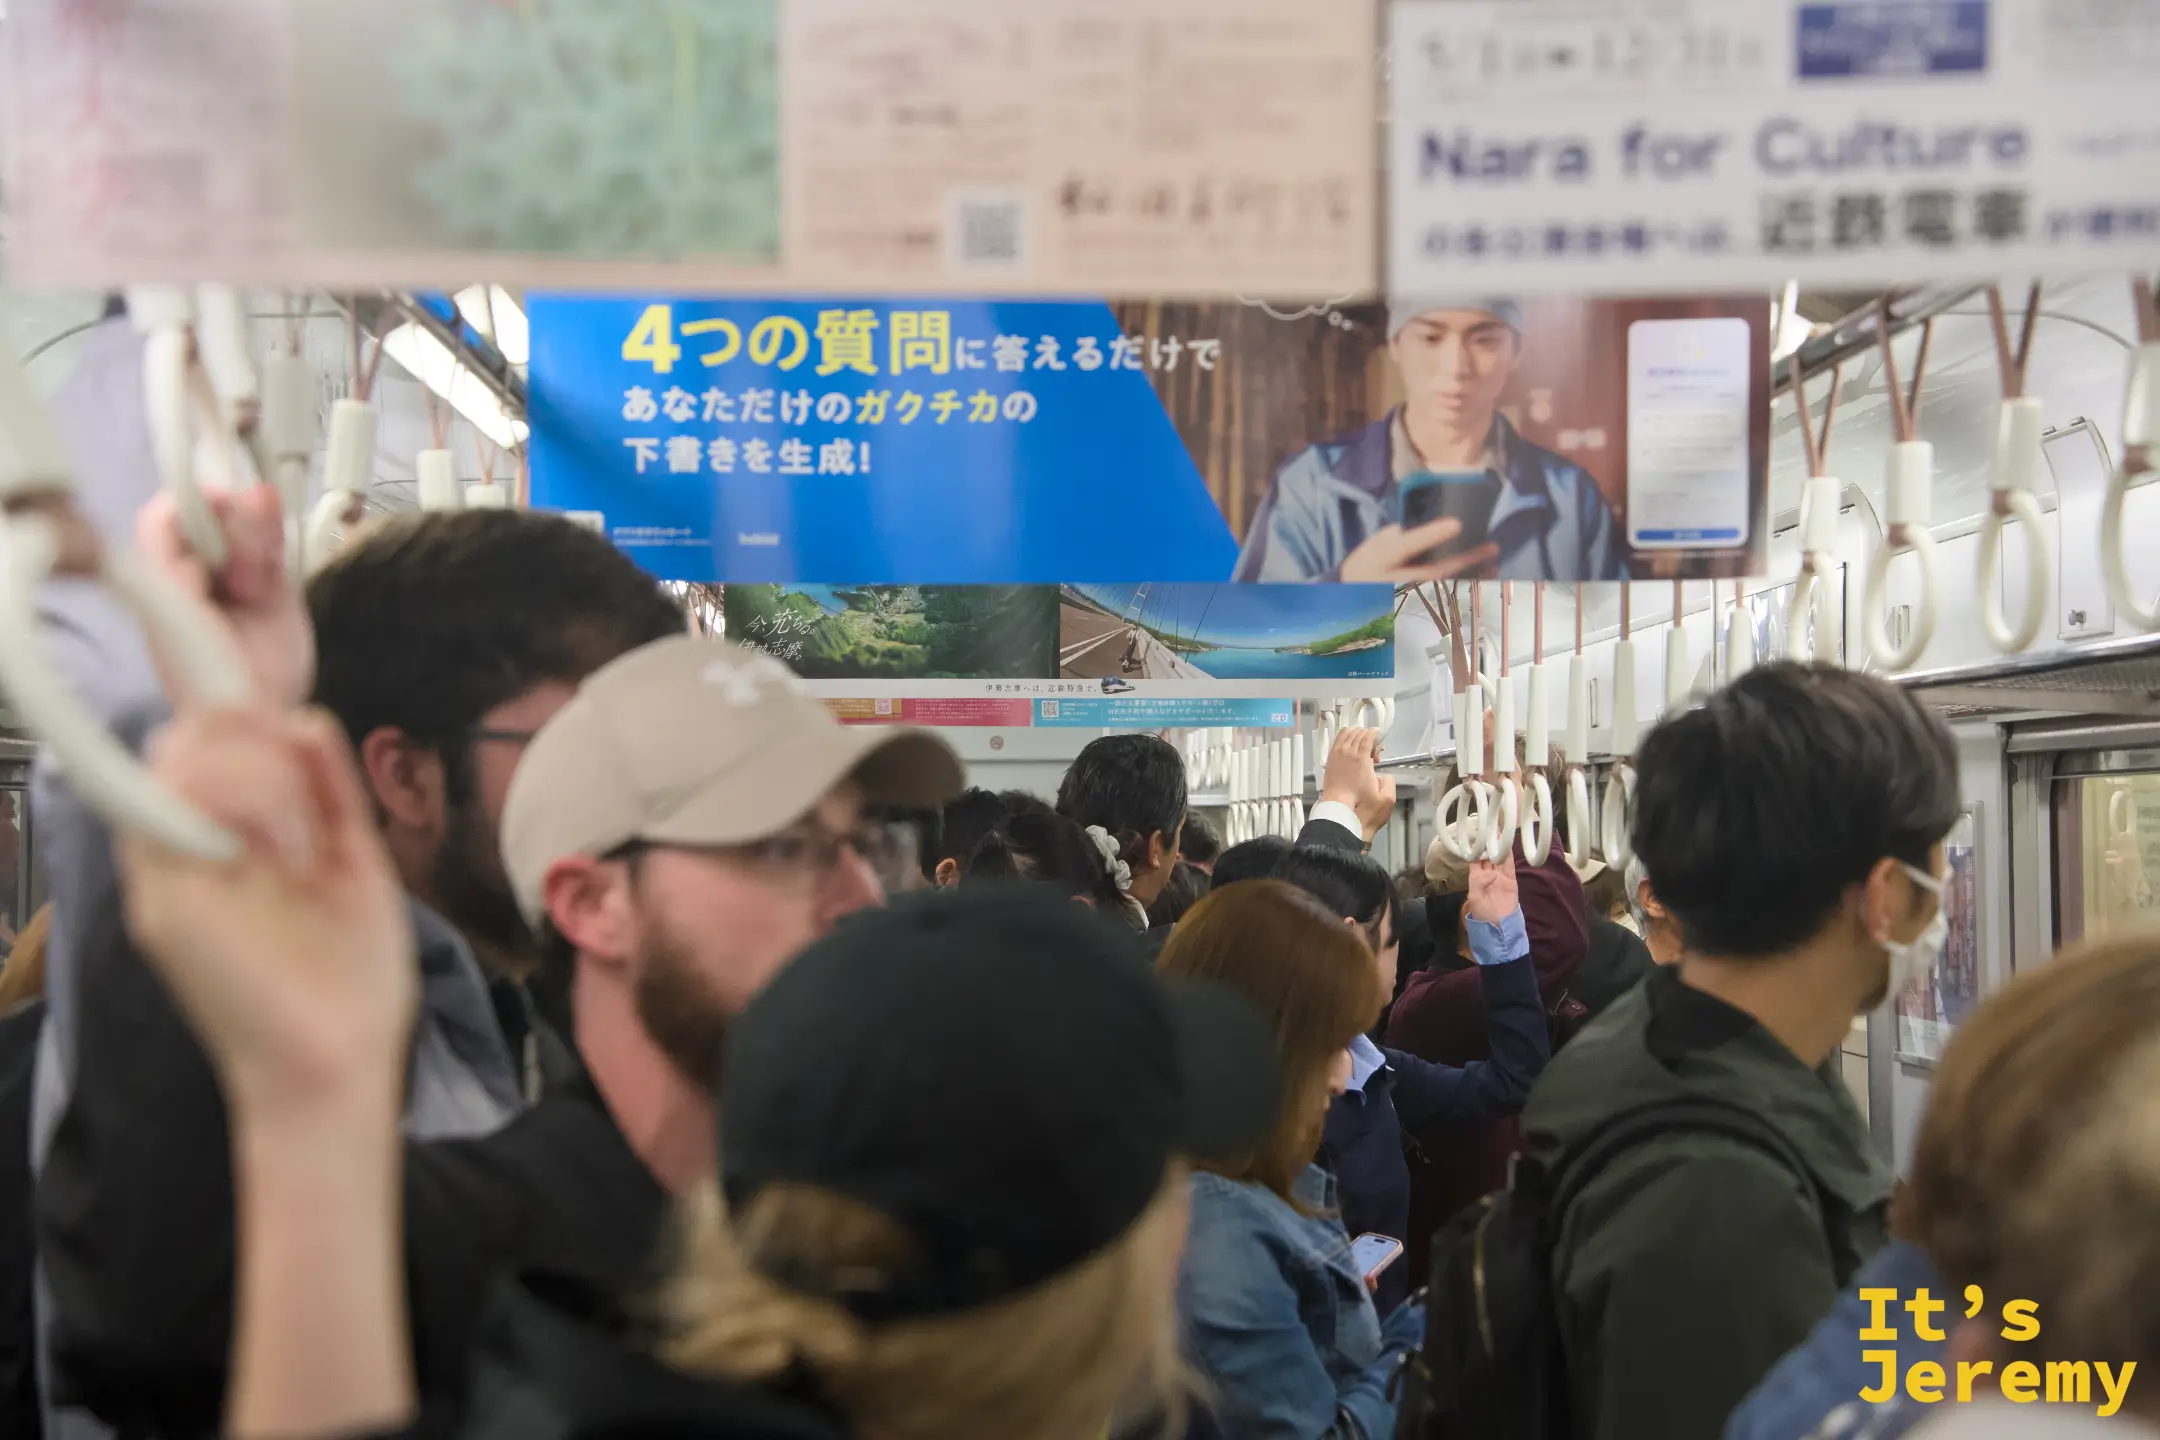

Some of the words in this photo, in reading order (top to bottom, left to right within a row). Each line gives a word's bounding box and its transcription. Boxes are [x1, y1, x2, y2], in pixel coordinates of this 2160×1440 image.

[1418, 124, 1590, 184] Nara
[1620, 119, 1722, 177] for
[1754, 116, 2031, 176] Culture
[621, 304, 1221, 376] 4つの質問に答えるだけで
[622, 385, 1037, 425] あなただけのガクチカの
